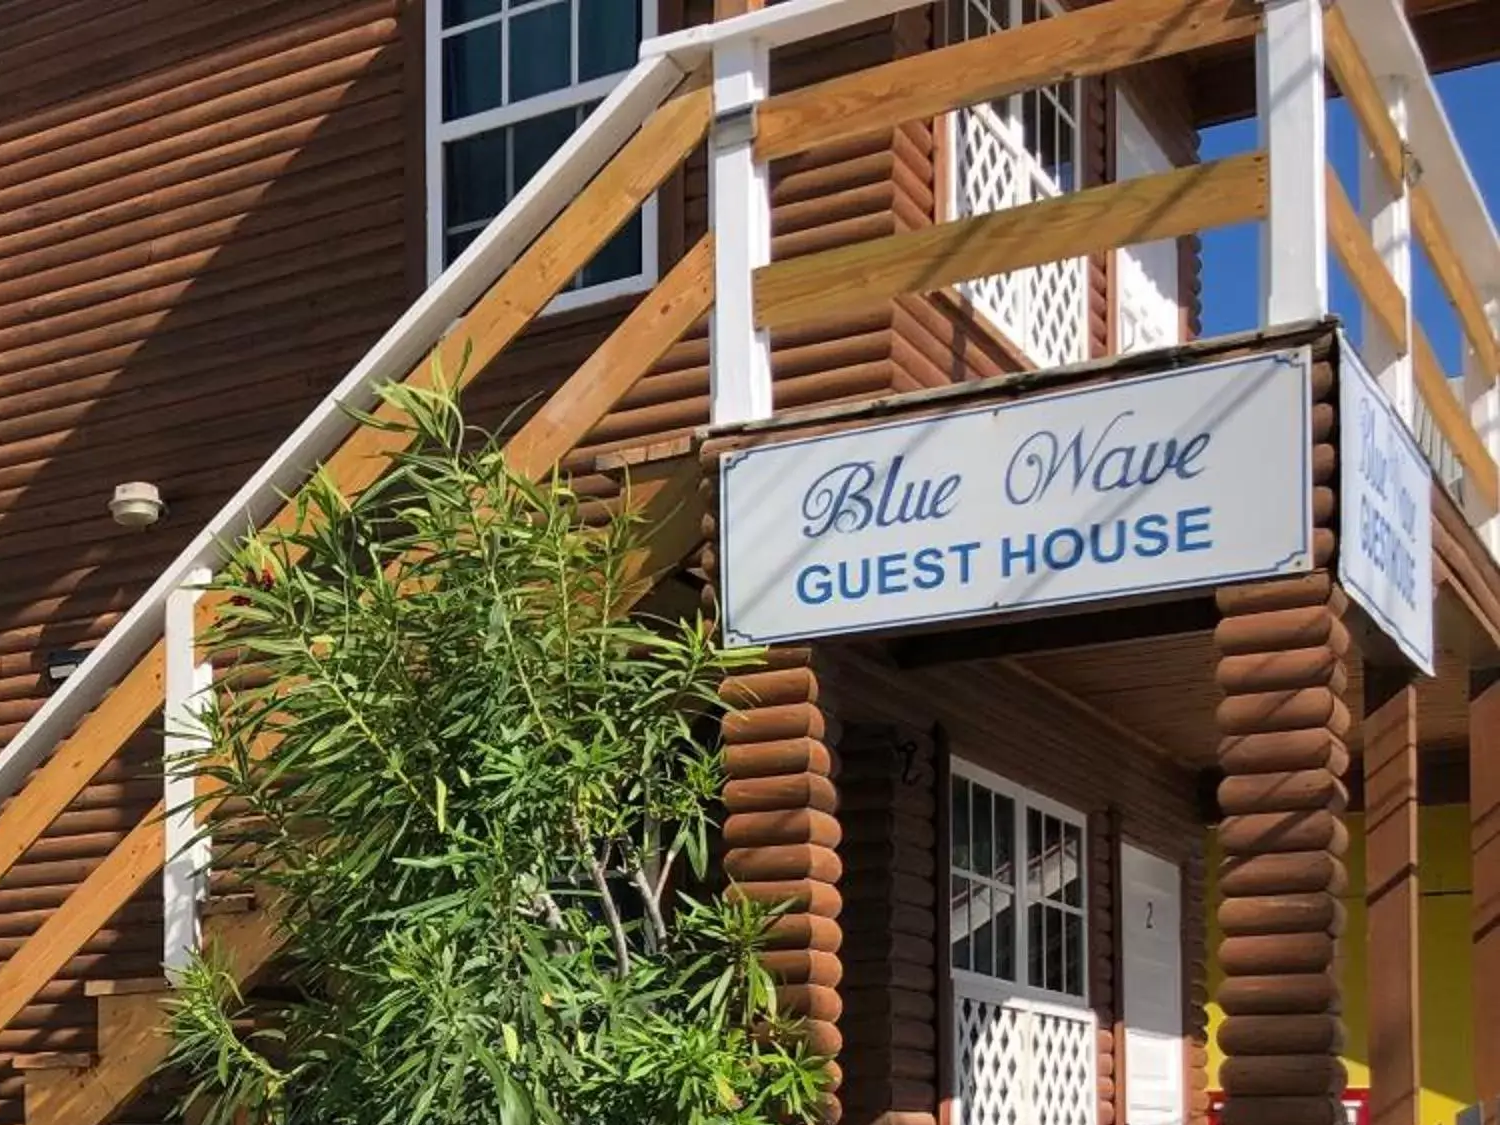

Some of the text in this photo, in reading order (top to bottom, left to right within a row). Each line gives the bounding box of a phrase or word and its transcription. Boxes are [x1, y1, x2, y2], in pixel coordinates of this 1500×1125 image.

[802, 410, 1211, 538] Blue Wave
[796, 506, 1213, 605] GUEST HOUSE
